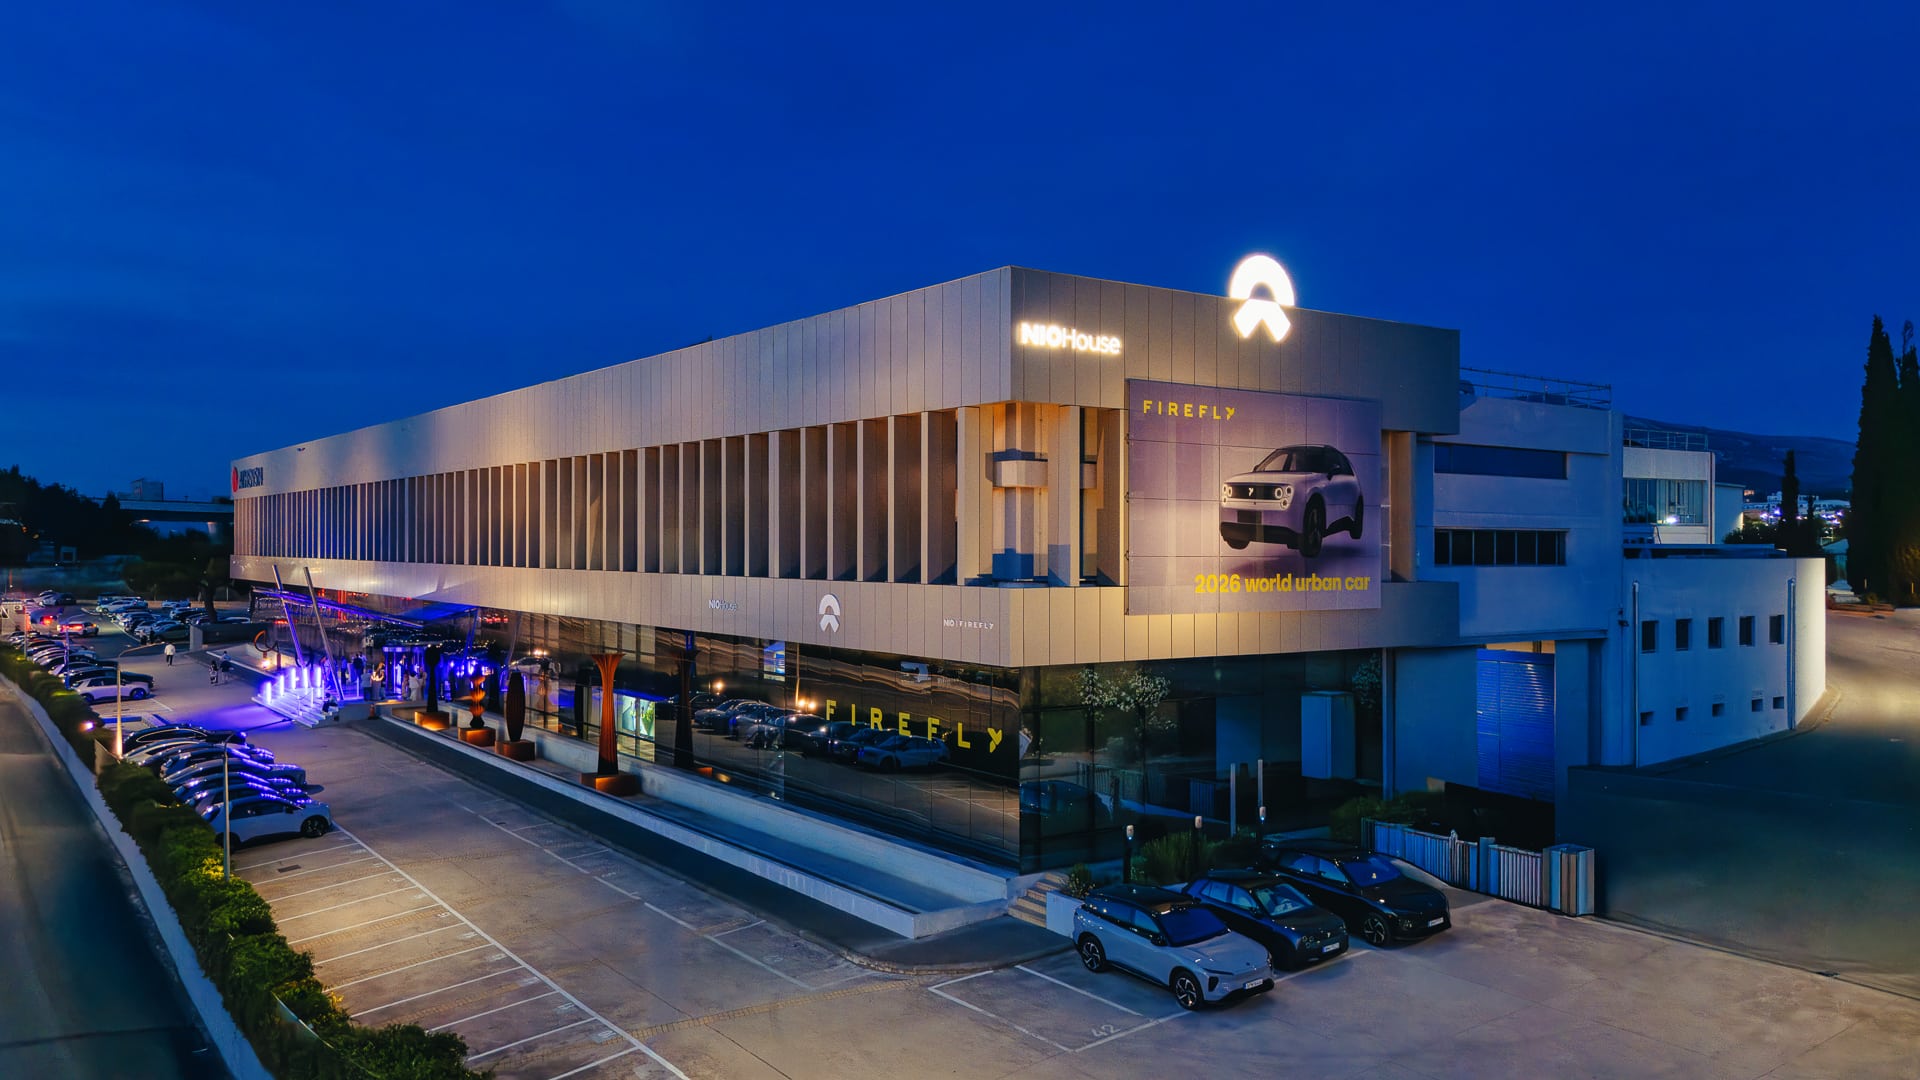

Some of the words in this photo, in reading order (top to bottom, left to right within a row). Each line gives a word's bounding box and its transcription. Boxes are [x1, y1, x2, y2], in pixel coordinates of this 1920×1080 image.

[1142, 399, 1236, 421] FIREFLY
[1194, 573, 1241, 593] 2026
[1244, 572, 1293, 593] world
[1295, 572, 1342, 592] urban
[1345, 576, 1371, 591] car
[825, 699, 1003, 753] FIREFLY
[1090, 1024, 1121, 1038] 42
